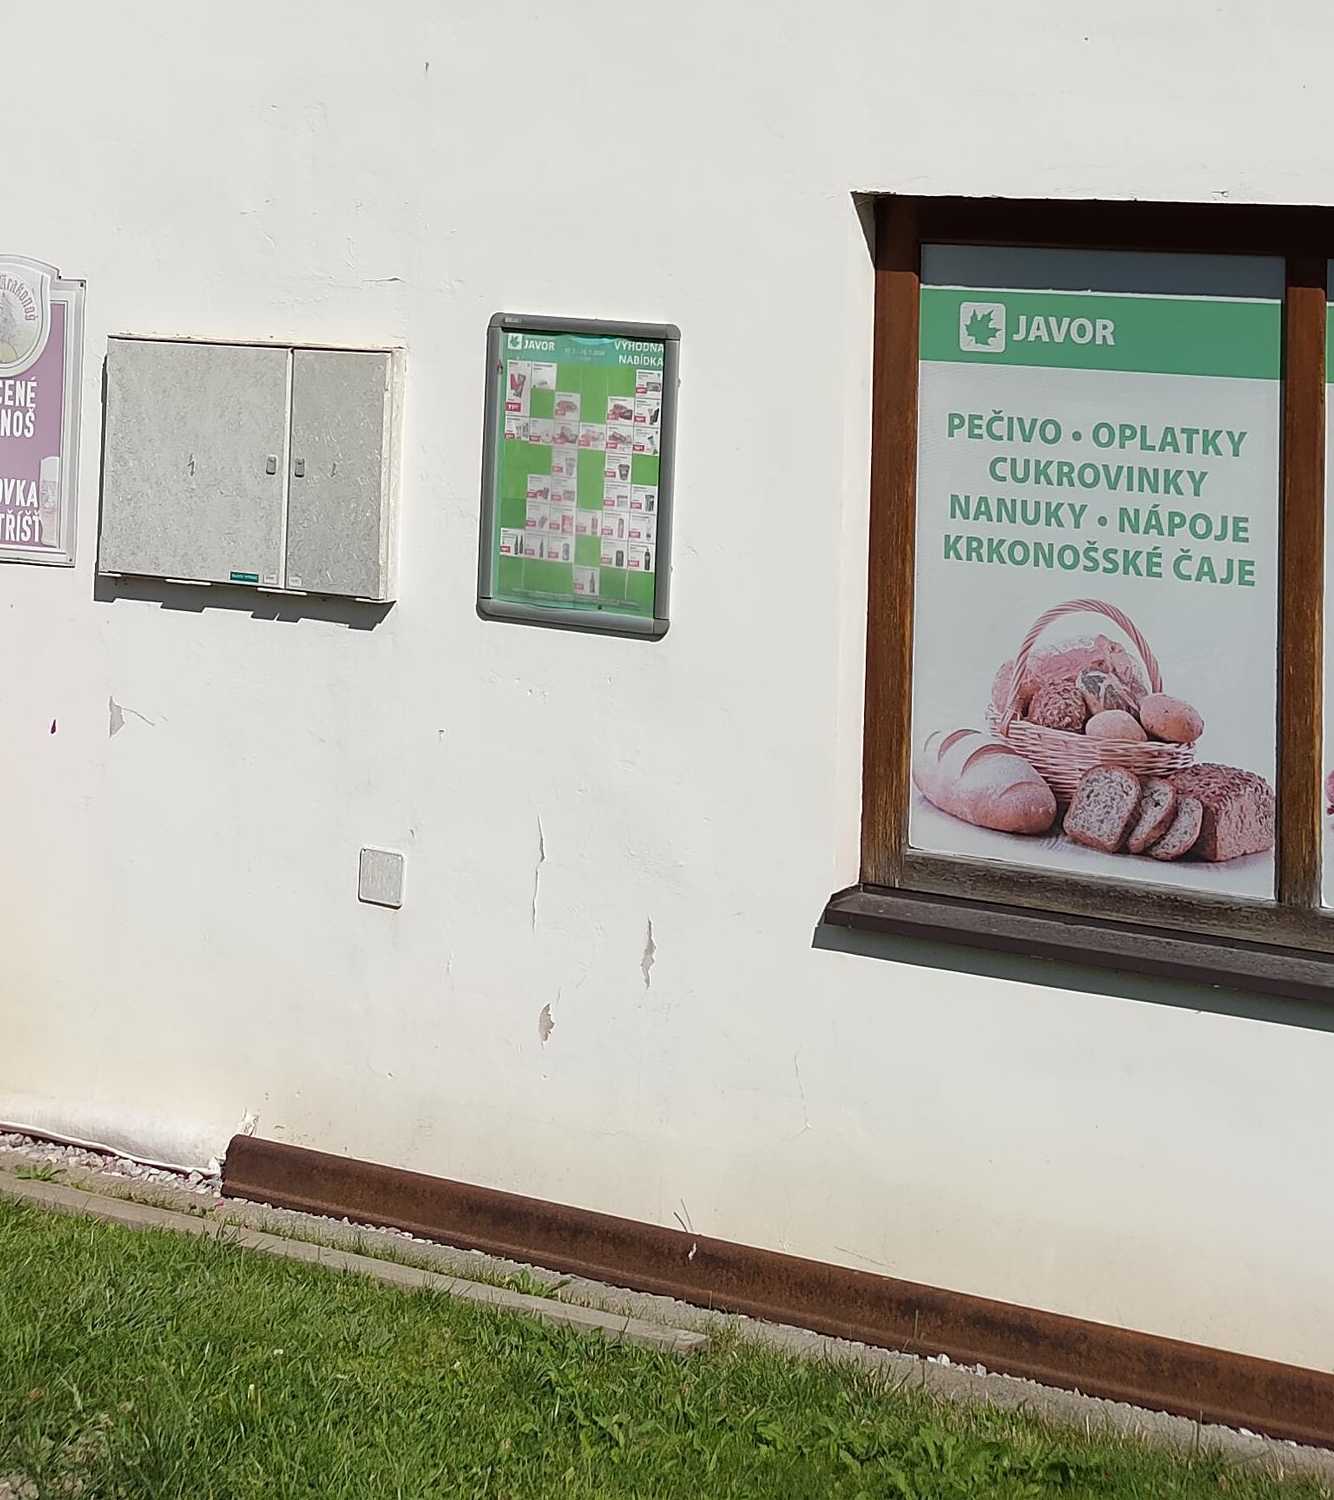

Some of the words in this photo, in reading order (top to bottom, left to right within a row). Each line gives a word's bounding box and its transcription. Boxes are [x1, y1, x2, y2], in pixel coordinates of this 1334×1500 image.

[523, 339, 555, 351] JAVOR
[1012, 315, 1116, 346] JAVOR
[618, 353, 664, 367] NABÍDKA
[947, 409, 1062, 445] PEČIVO
[1092, 422, 1248, 457] OPLATKY
[988, 456, 1209, 498] CUKROVINKY
[949, 494, 1089, 530] NANUKY
[1118, 503, 1250, 543] NÁPOJE
[943, 533, 1163, 579] KRKONOŠSKÉ
[1172, 548, 1256, 587] ČAJE
